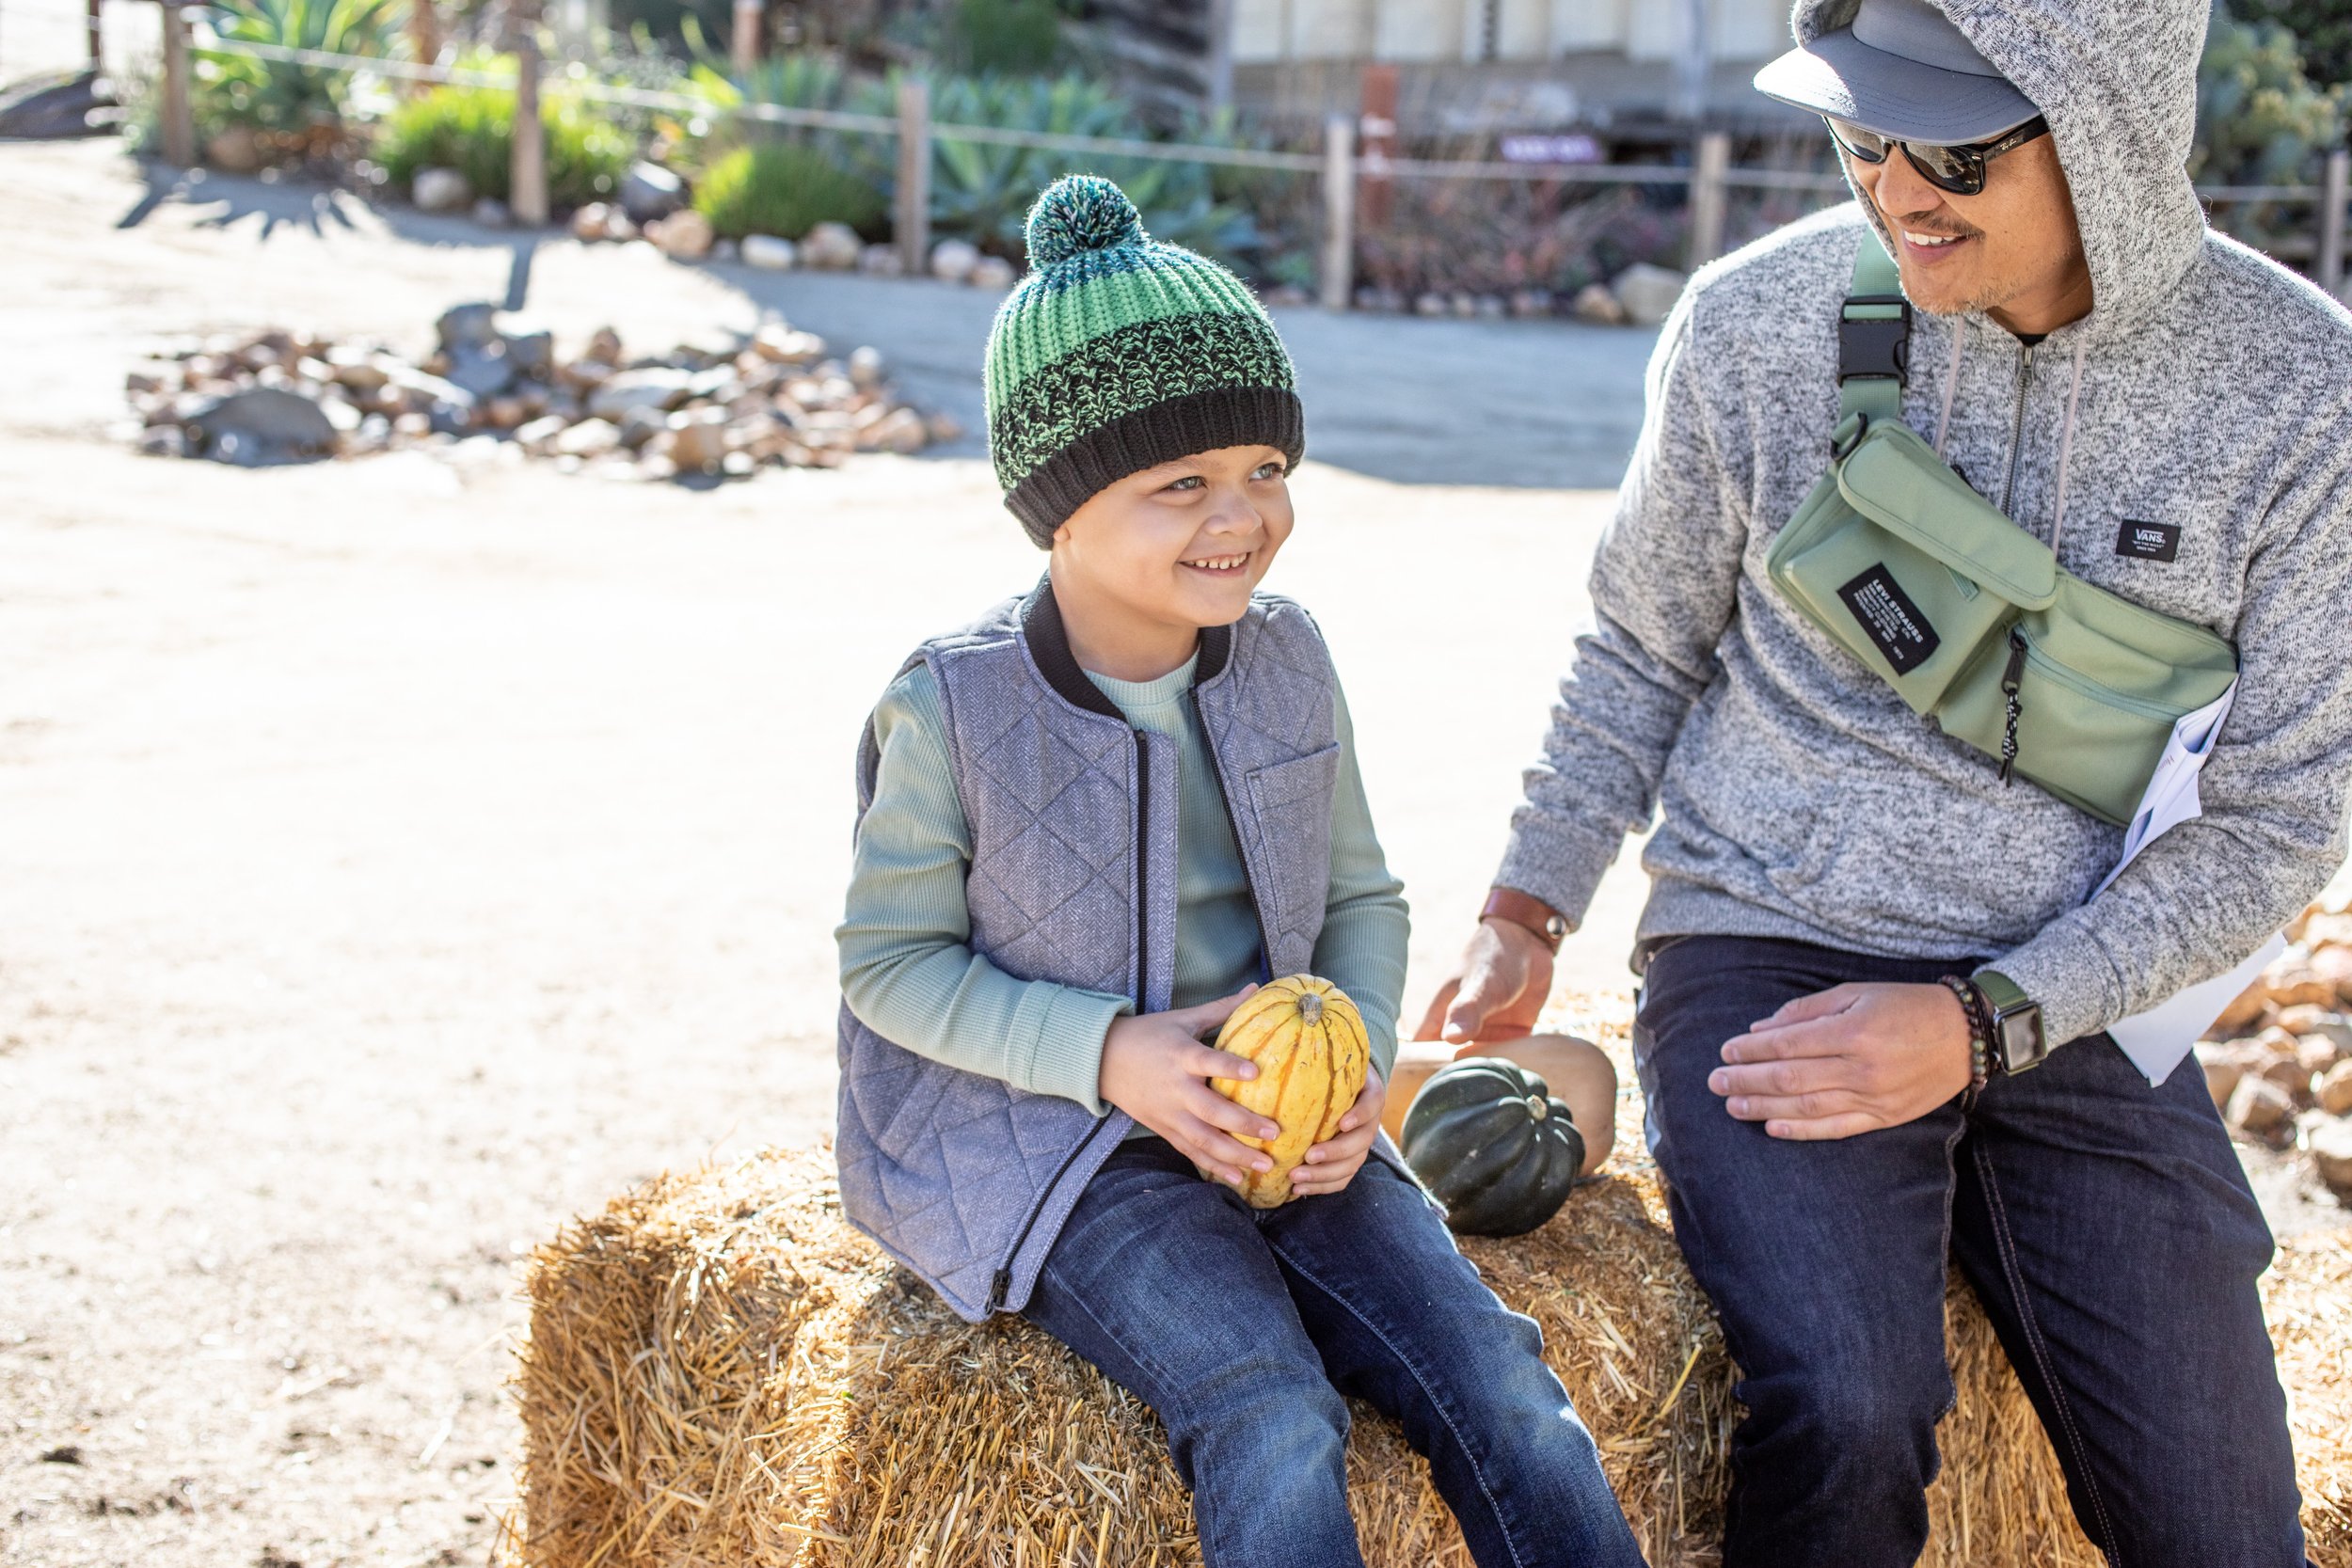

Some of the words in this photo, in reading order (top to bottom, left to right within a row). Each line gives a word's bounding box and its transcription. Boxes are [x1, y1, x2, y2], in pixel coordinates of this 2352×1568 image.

[2135, 528, 2165, 544] VANS
[1872, 578, 1891, 601] LEVI
[1889, 600, 1924, 643] STRAUSS
